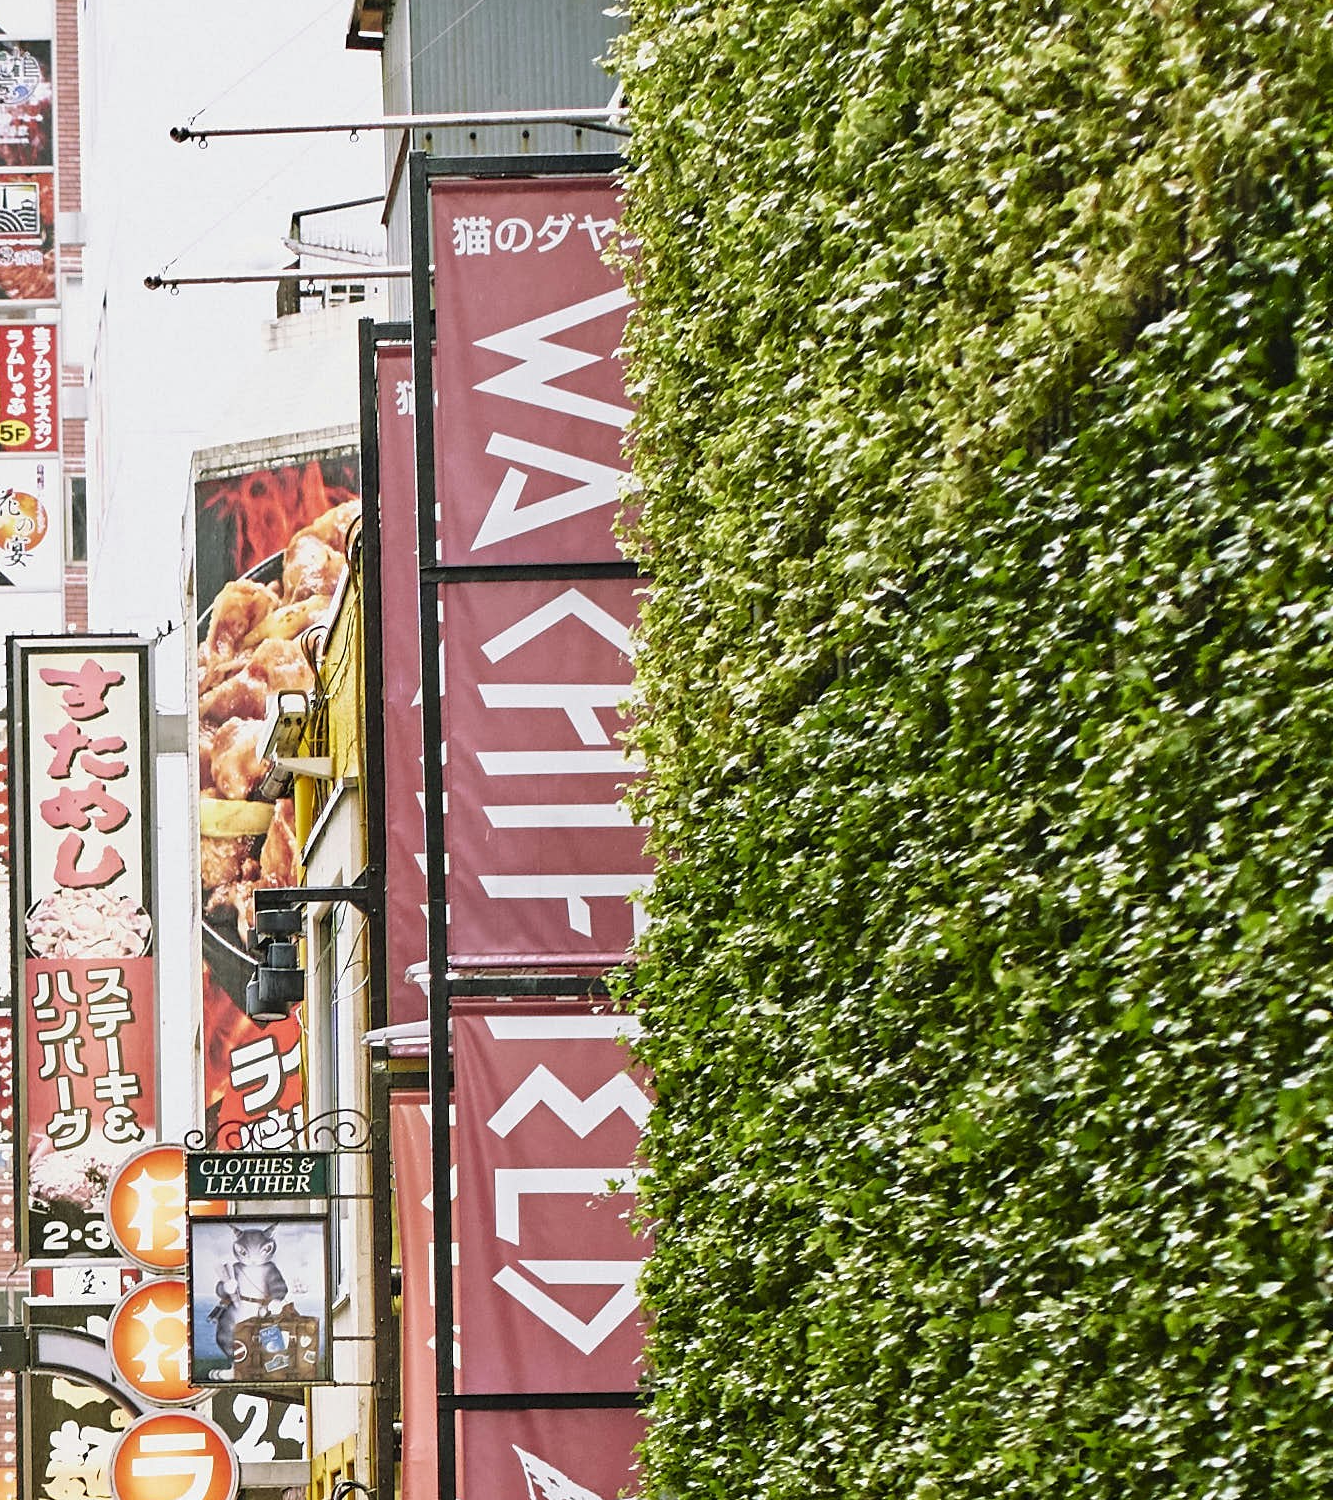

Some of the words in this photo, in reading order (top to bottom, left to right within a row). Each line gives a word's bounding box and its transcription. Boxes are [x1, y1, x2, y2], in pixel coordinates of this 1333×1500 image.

[452, 212, 644, 256] 猫のダヤ
[6, 329, 27, 416] ラムしゃぶ
[0, 424, 27, 442] 5F
[33, 970, 89, 1151] ハンバーグ
[86, 967, 145, 1142] ステーキ&
[199, 1158, 293, 1175] CLOTHES
[298, 1156, 315, 1173] &
[205, 1174, 311, 1194] LEATHER
